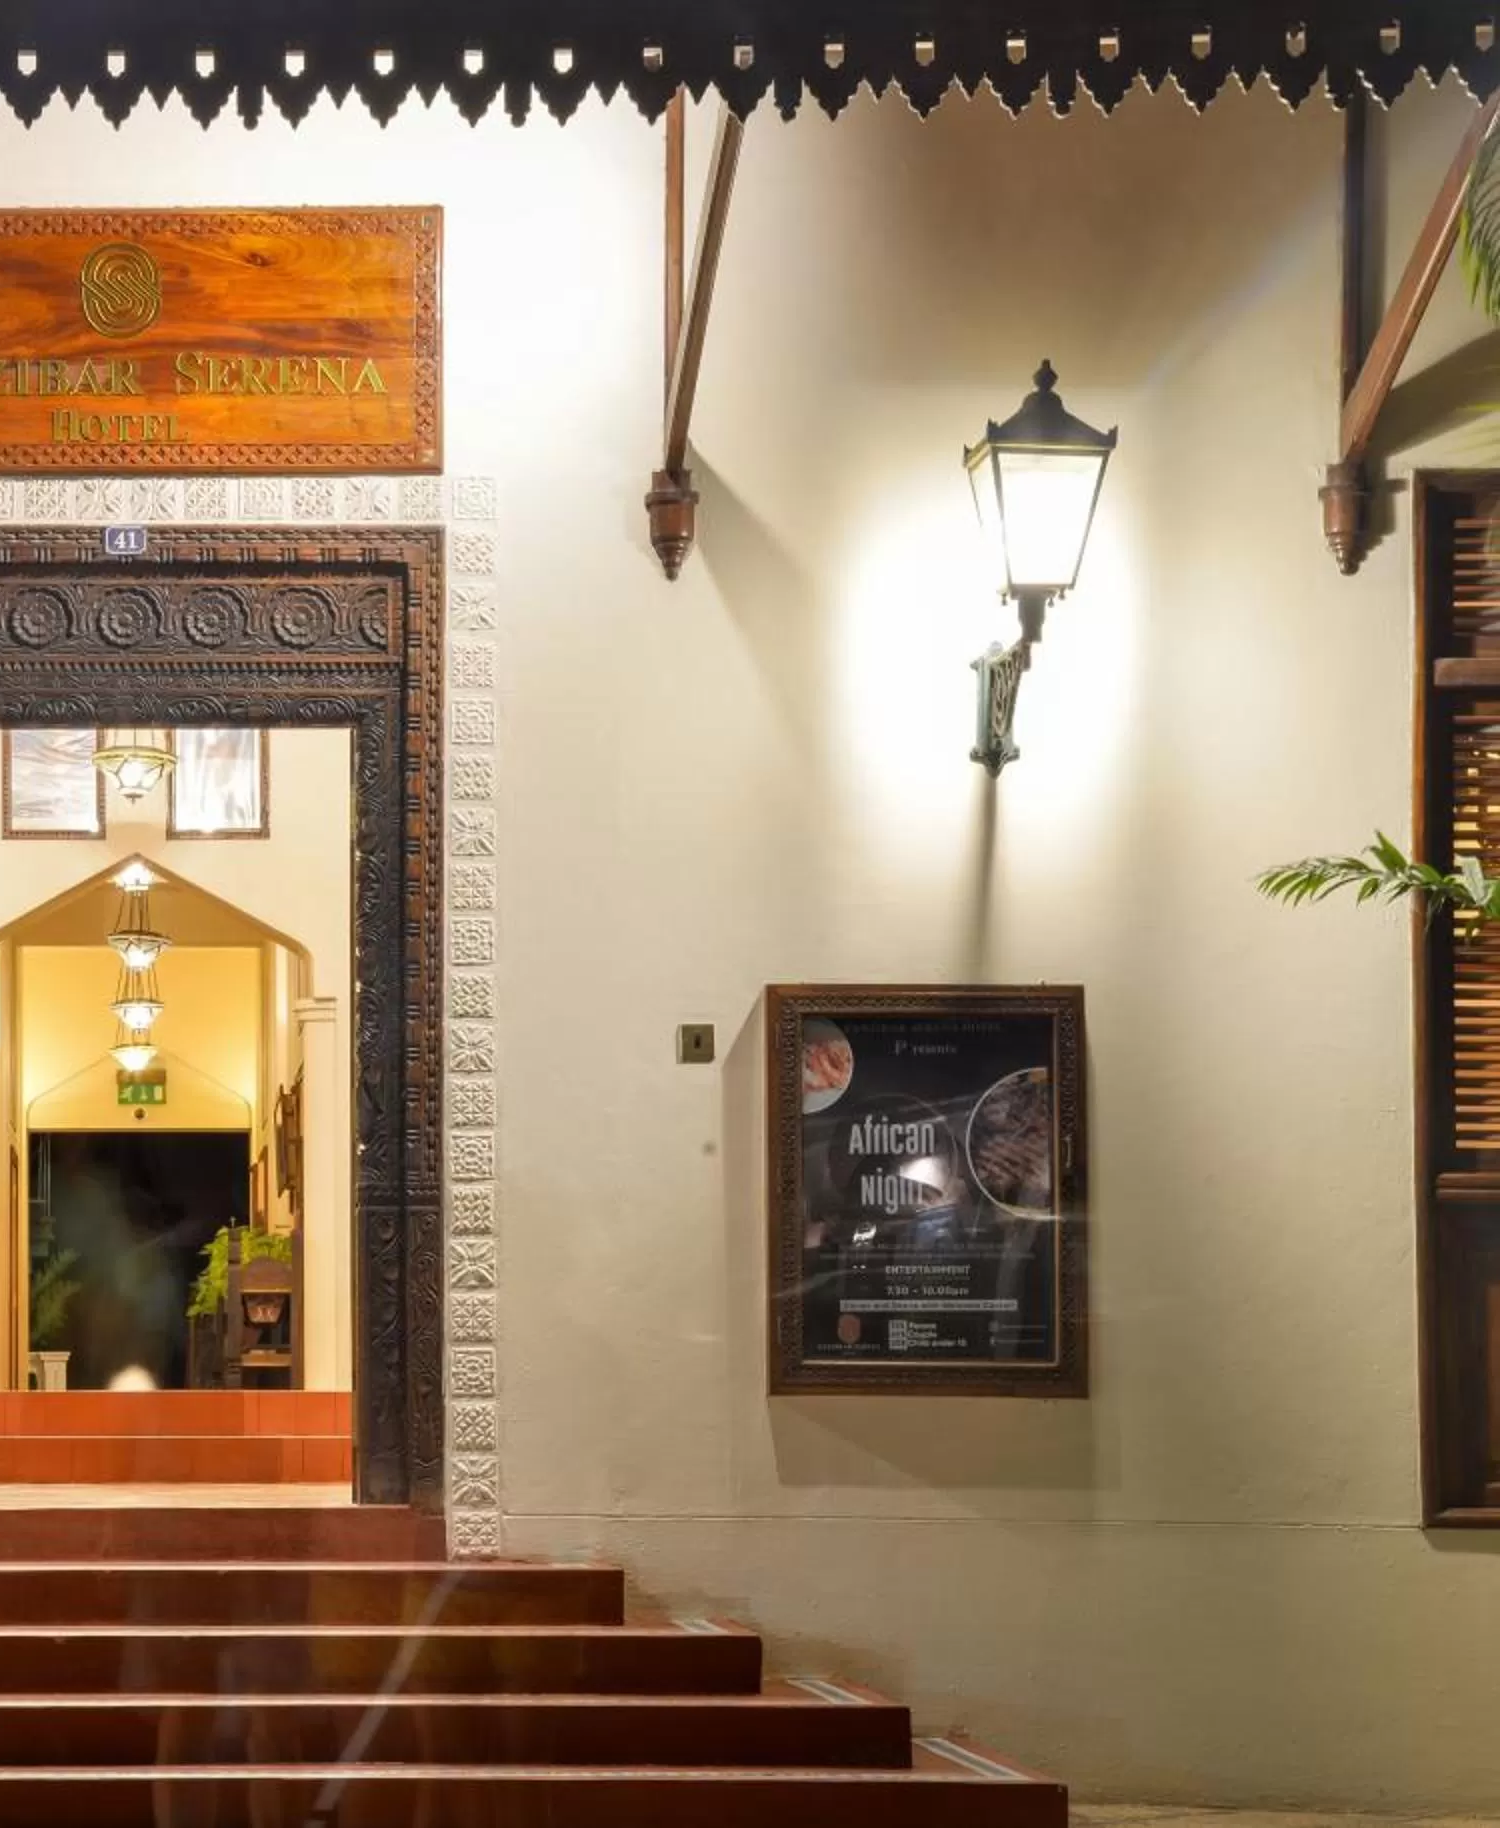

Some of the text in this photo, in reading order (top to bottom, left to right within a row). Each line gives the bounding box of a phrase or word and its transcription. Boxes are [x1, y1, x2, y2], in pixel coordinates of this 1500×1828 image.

[174, 350, 389, 397] SERENA
[51, 408, 189, 444] HOTEL
[114, 530, 140, 549] 41
[848, 1114, 935, 1156] African
